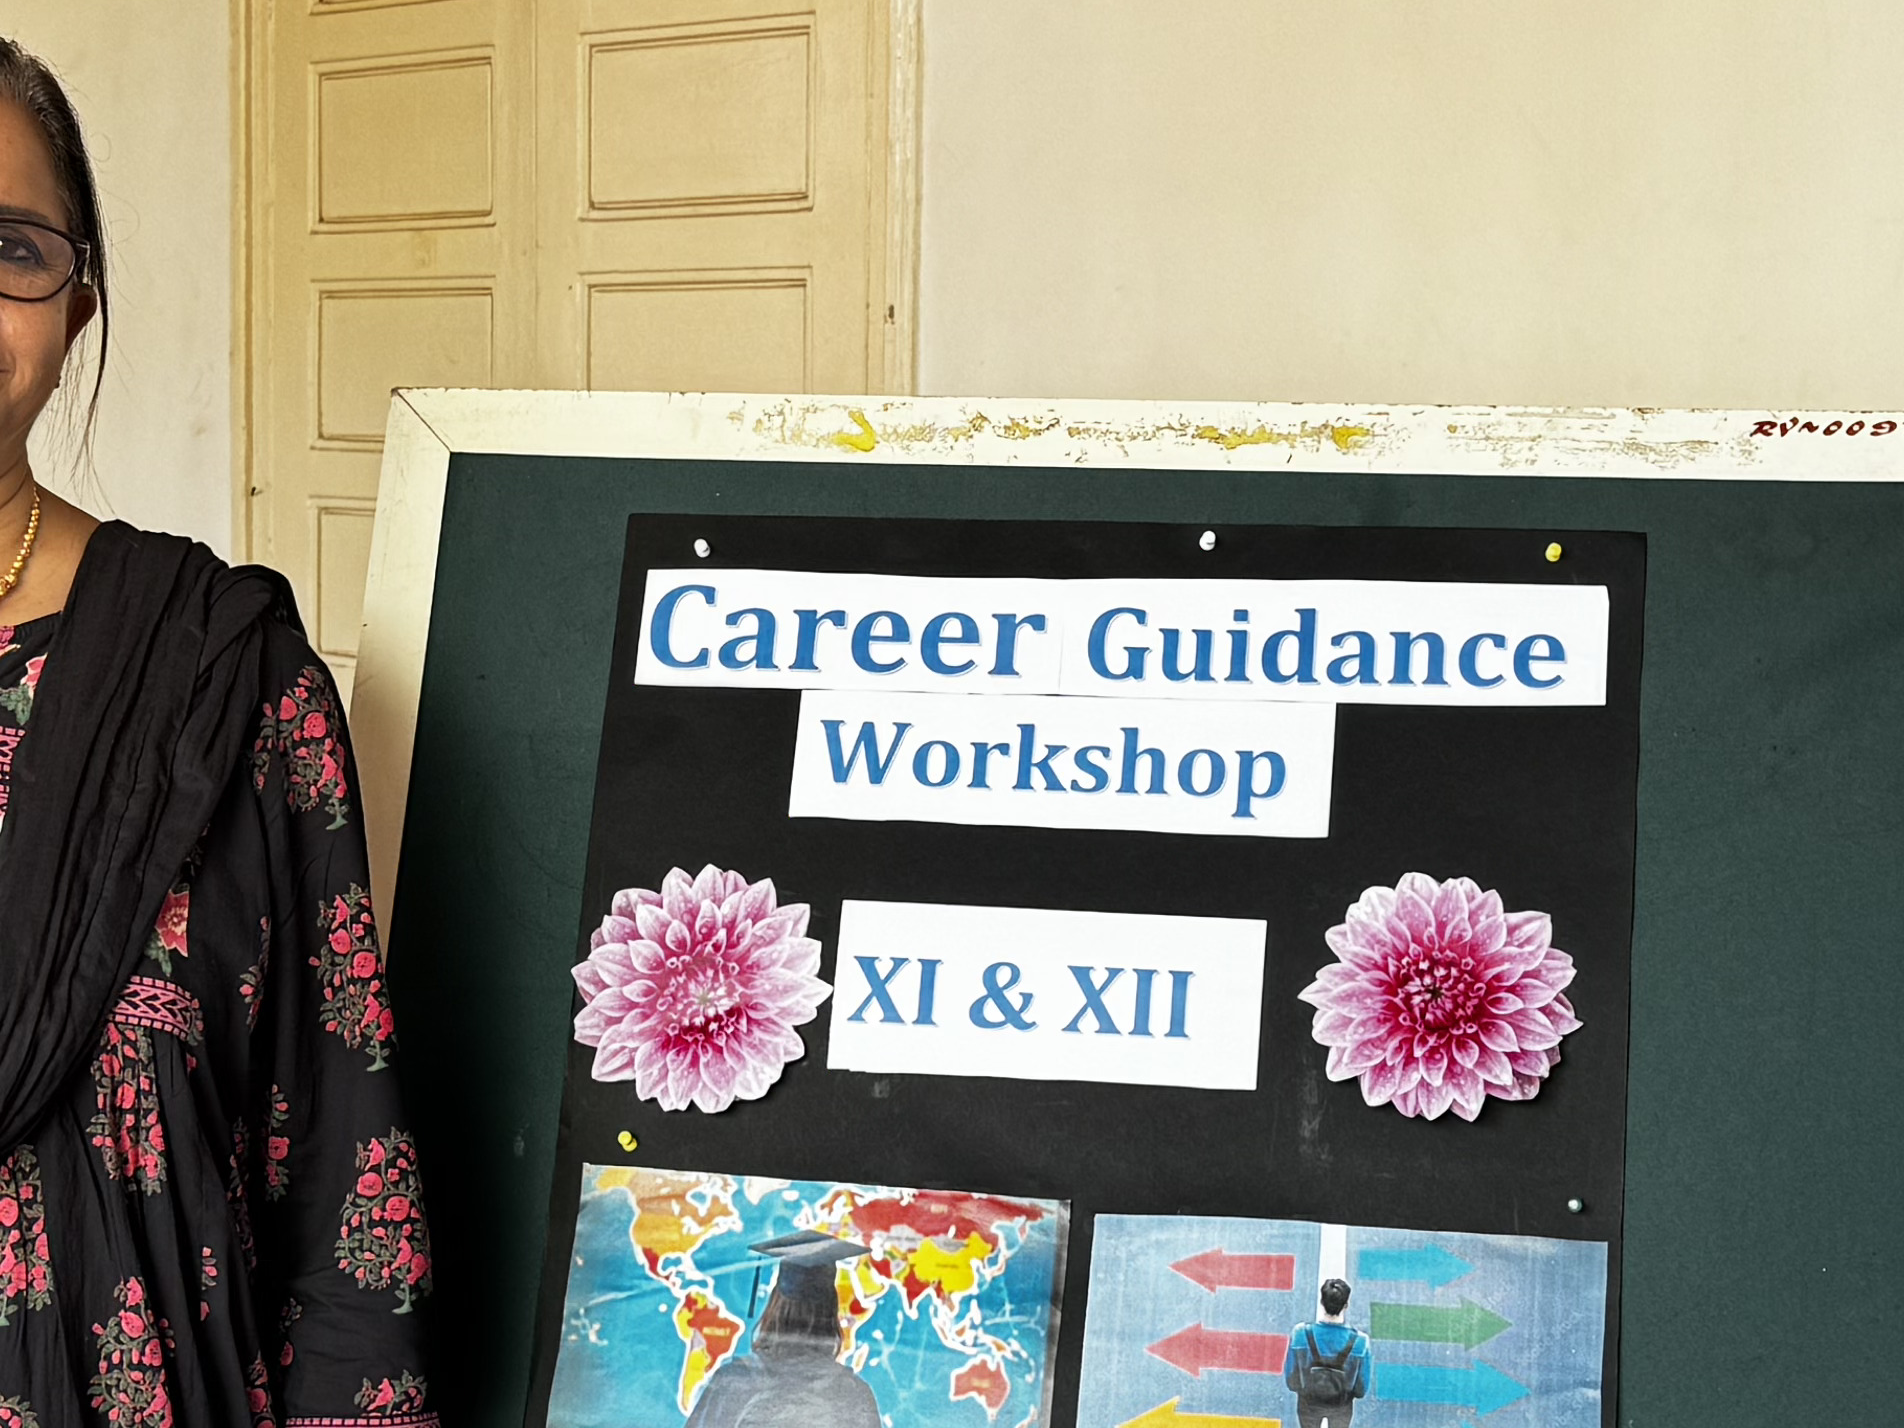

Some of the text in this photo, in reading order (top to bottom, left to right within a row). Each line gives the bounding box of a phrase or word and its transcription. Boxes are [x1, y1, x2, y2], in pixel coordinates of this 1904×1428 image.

[648, 583, 1568, 690] Career Guidance
[821, 718, 1288, 820] Workshop
[847, 954, 1194, 1041] XI & XII
